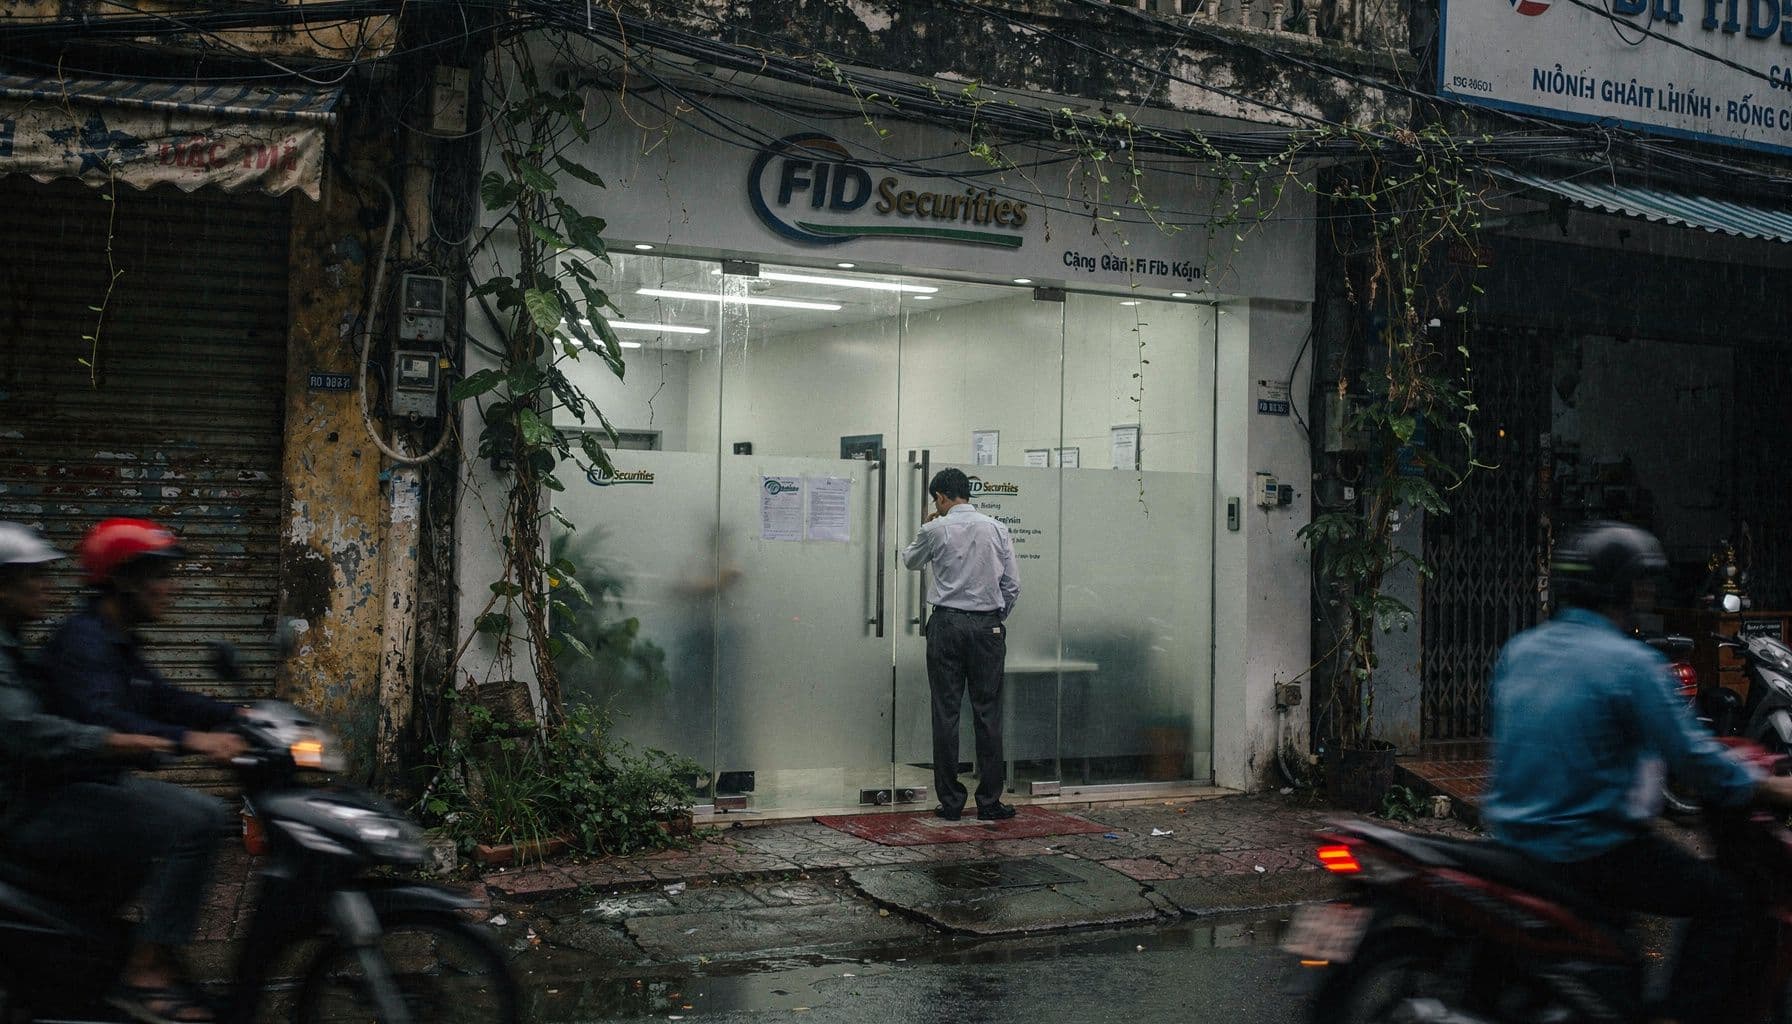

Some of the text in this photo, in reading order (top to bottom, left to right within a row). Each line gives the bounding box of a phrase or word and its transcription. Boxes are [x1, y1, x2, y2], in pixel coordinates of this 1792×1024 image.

[1779, 109, 1792, 131] C
[777, 158, 1029, 227] FID Securities
[614, 469, 655, 481] Securities
